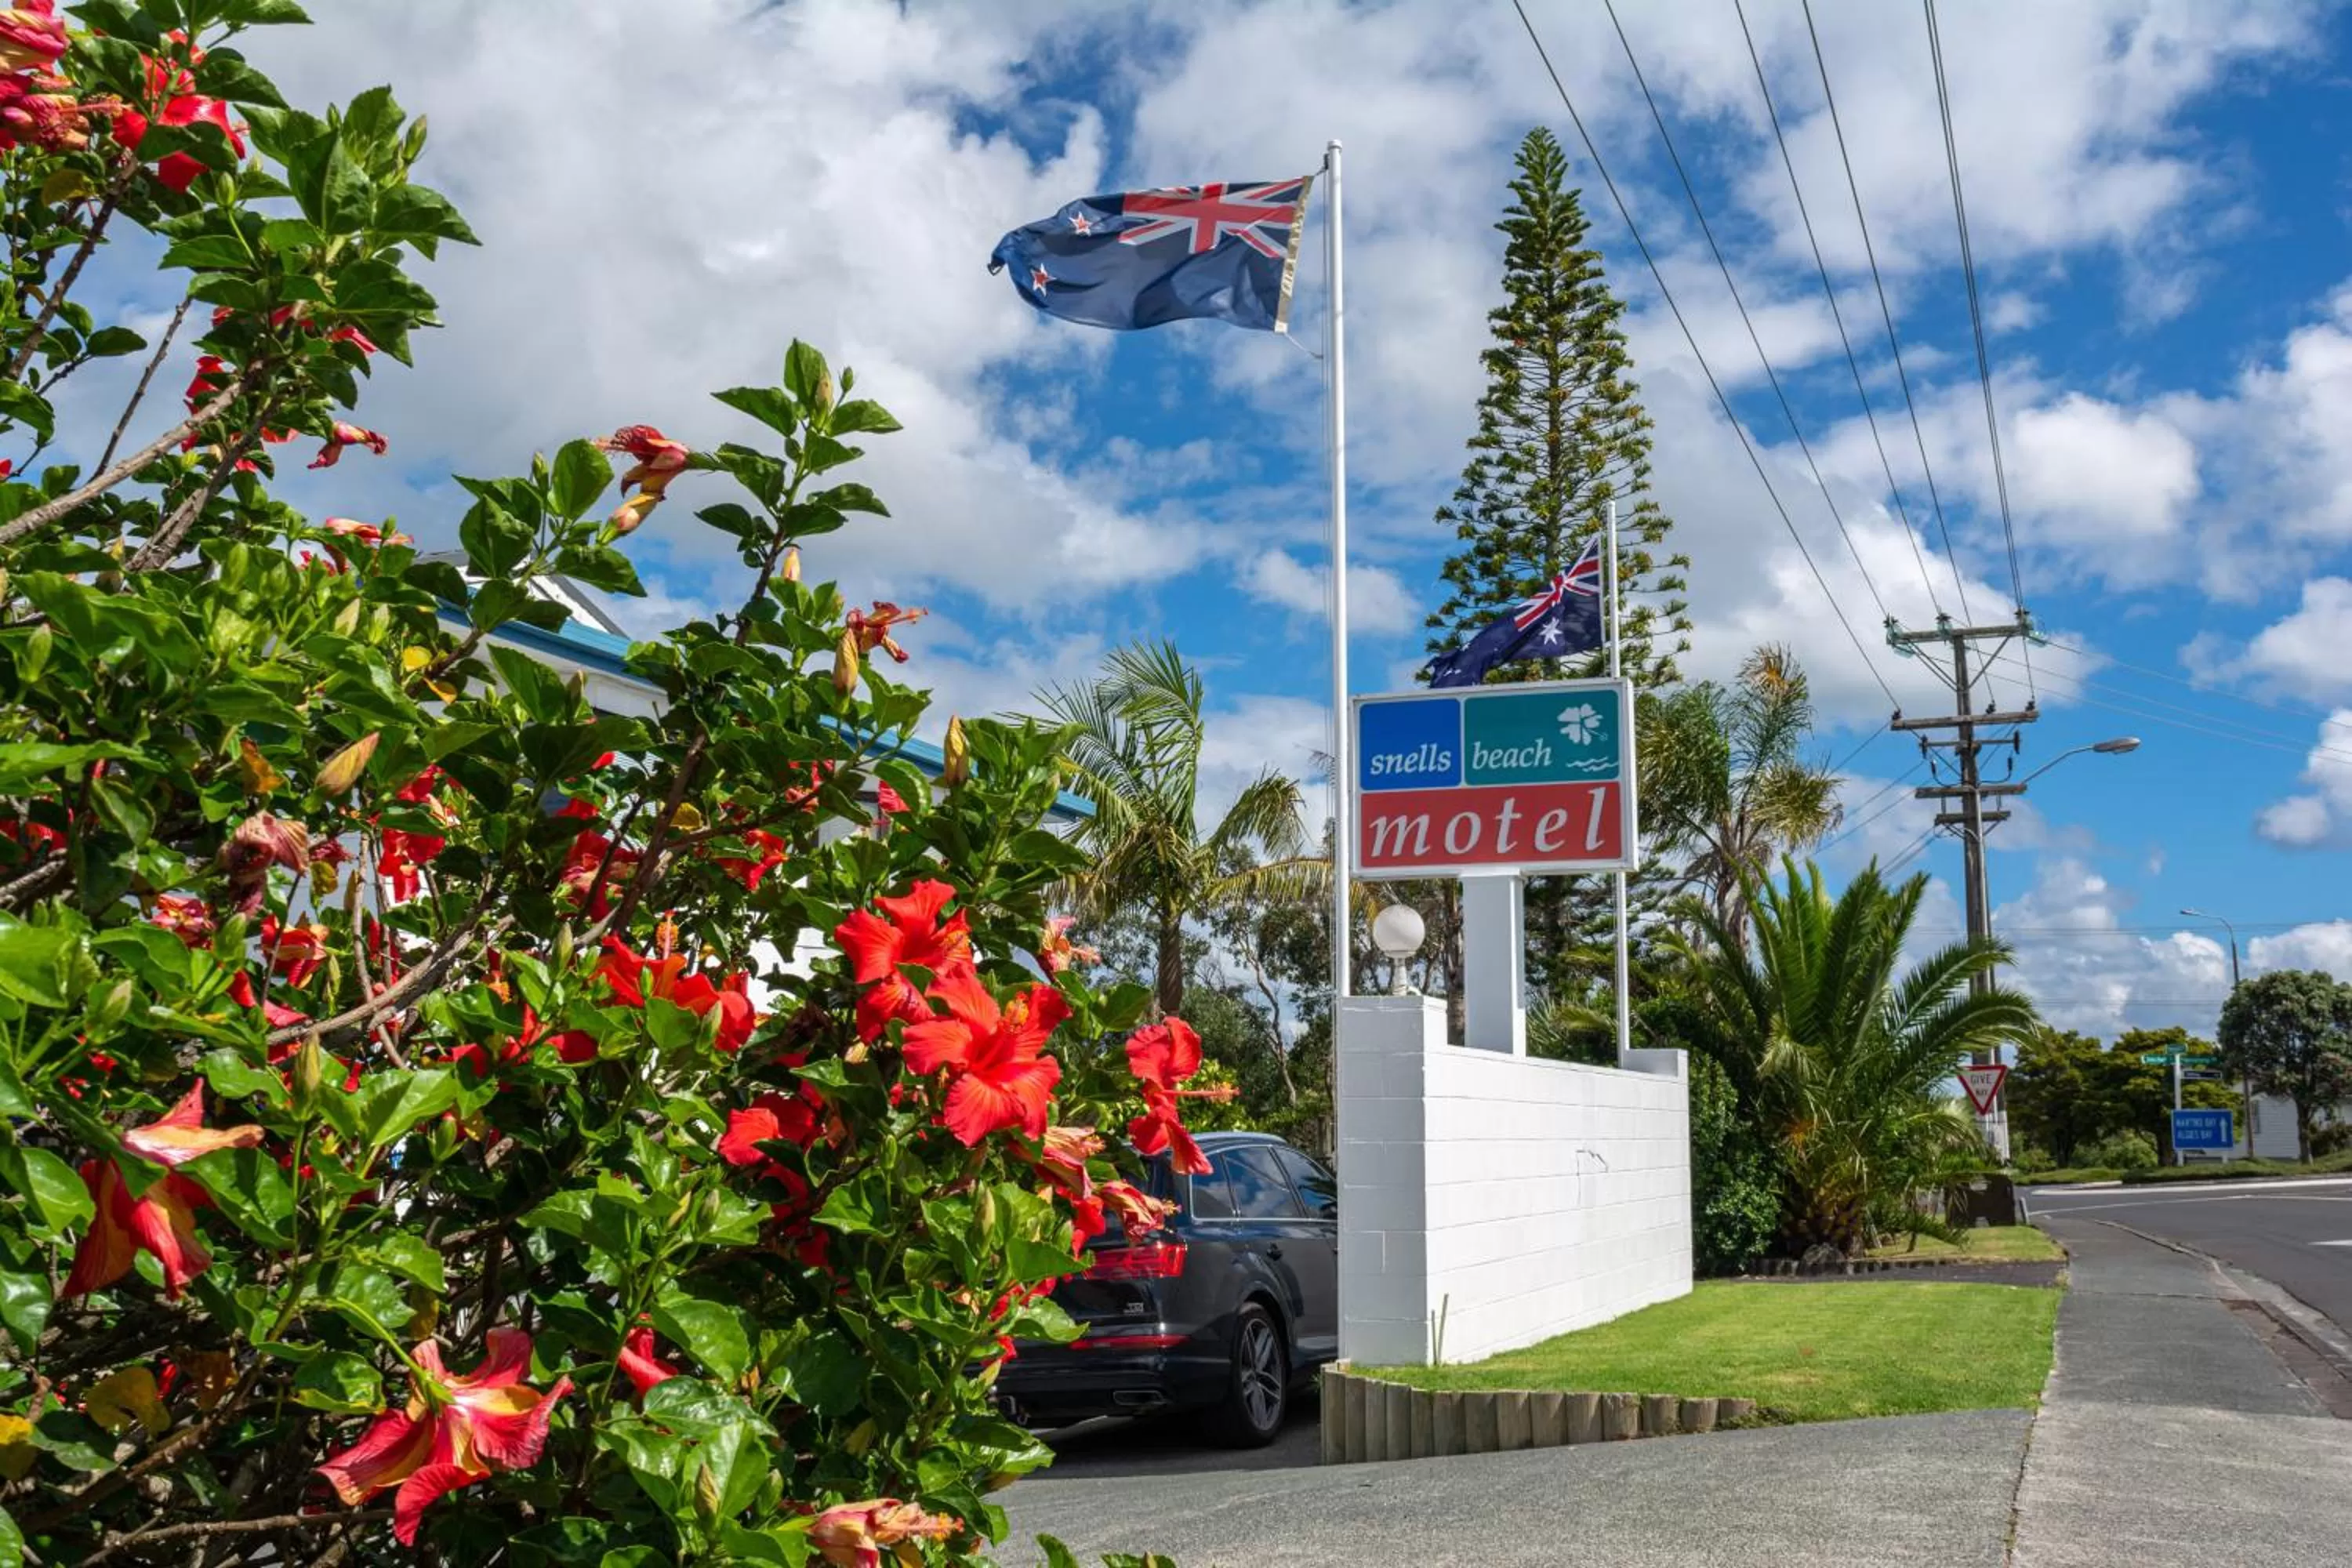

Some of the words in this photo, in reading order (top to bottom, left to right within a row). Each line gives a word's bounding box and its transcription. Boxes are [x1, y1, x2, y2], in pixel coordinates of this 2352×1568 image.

[1370, 743, 1452, 775] snells
[1471, 737, 1552, 770] beach
[1369, 786, 1606, 858] motel
[1970, 1073, 1992, 1085] GIVE
